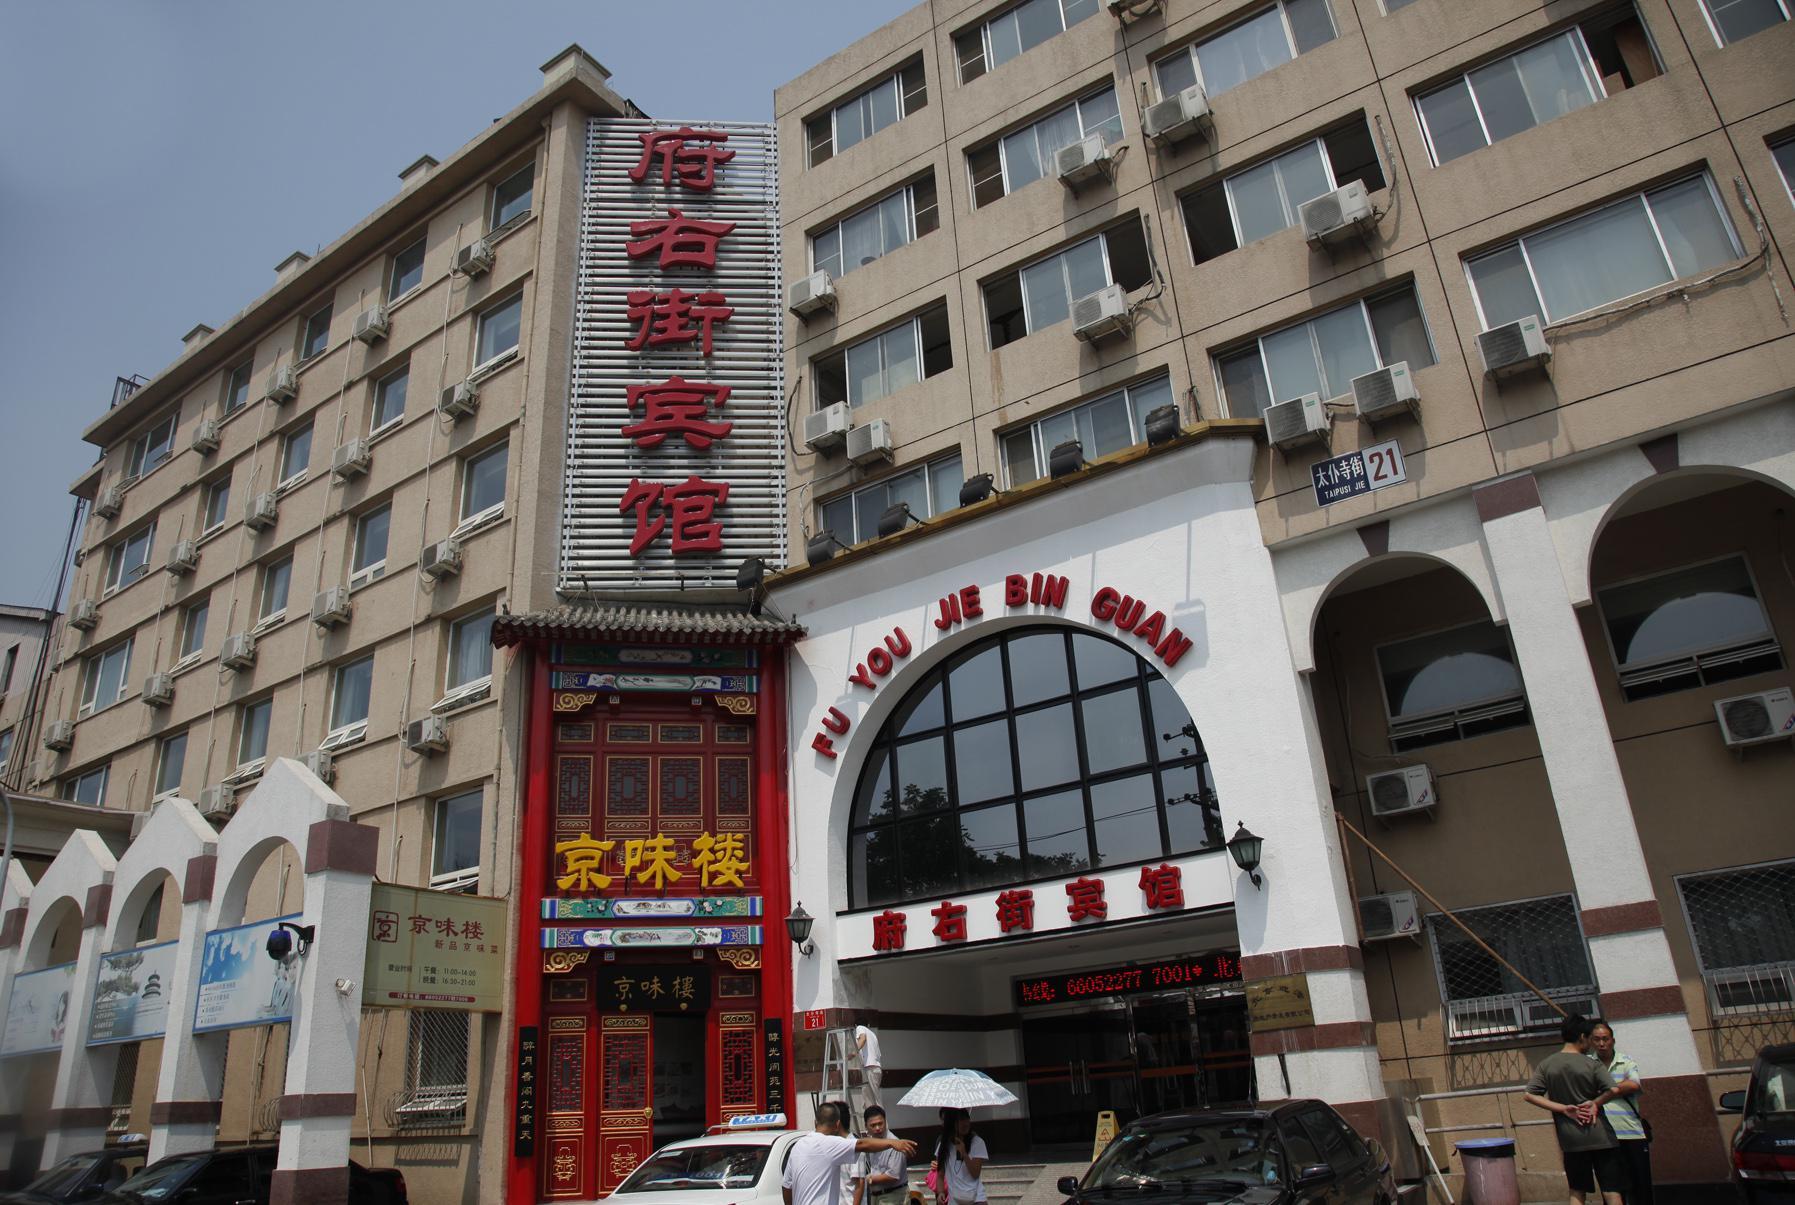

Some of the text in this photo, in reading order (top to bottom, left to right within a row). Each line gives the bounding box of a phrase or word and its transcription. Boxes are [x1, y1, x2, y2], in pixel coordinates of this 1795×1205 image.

[619, 127, 736, 557] 府右街宾馆
[1316, 456, 1364, 488] 太仆寺街
[1368, 448, 1398, 481] 21
[1324, 480, 1366, 499] TAIPUSI JIE
[811, 572, 1193, 760] FU YOU JIE BIN GUAN
[555, 831, 750, 892] 京味楼
[872, 863, 1186, 951] 府右街宾馆
[408, 914, 485, 940] 京味楼
[613, 975, 696, 1001] 京味樓
[1066, 970, 1142, 996] 66052277
[1152, 965, 1192, 985] 7001
[1214, 956, 1242, 979] 北
[811, 1018, 819, 1028] 21
